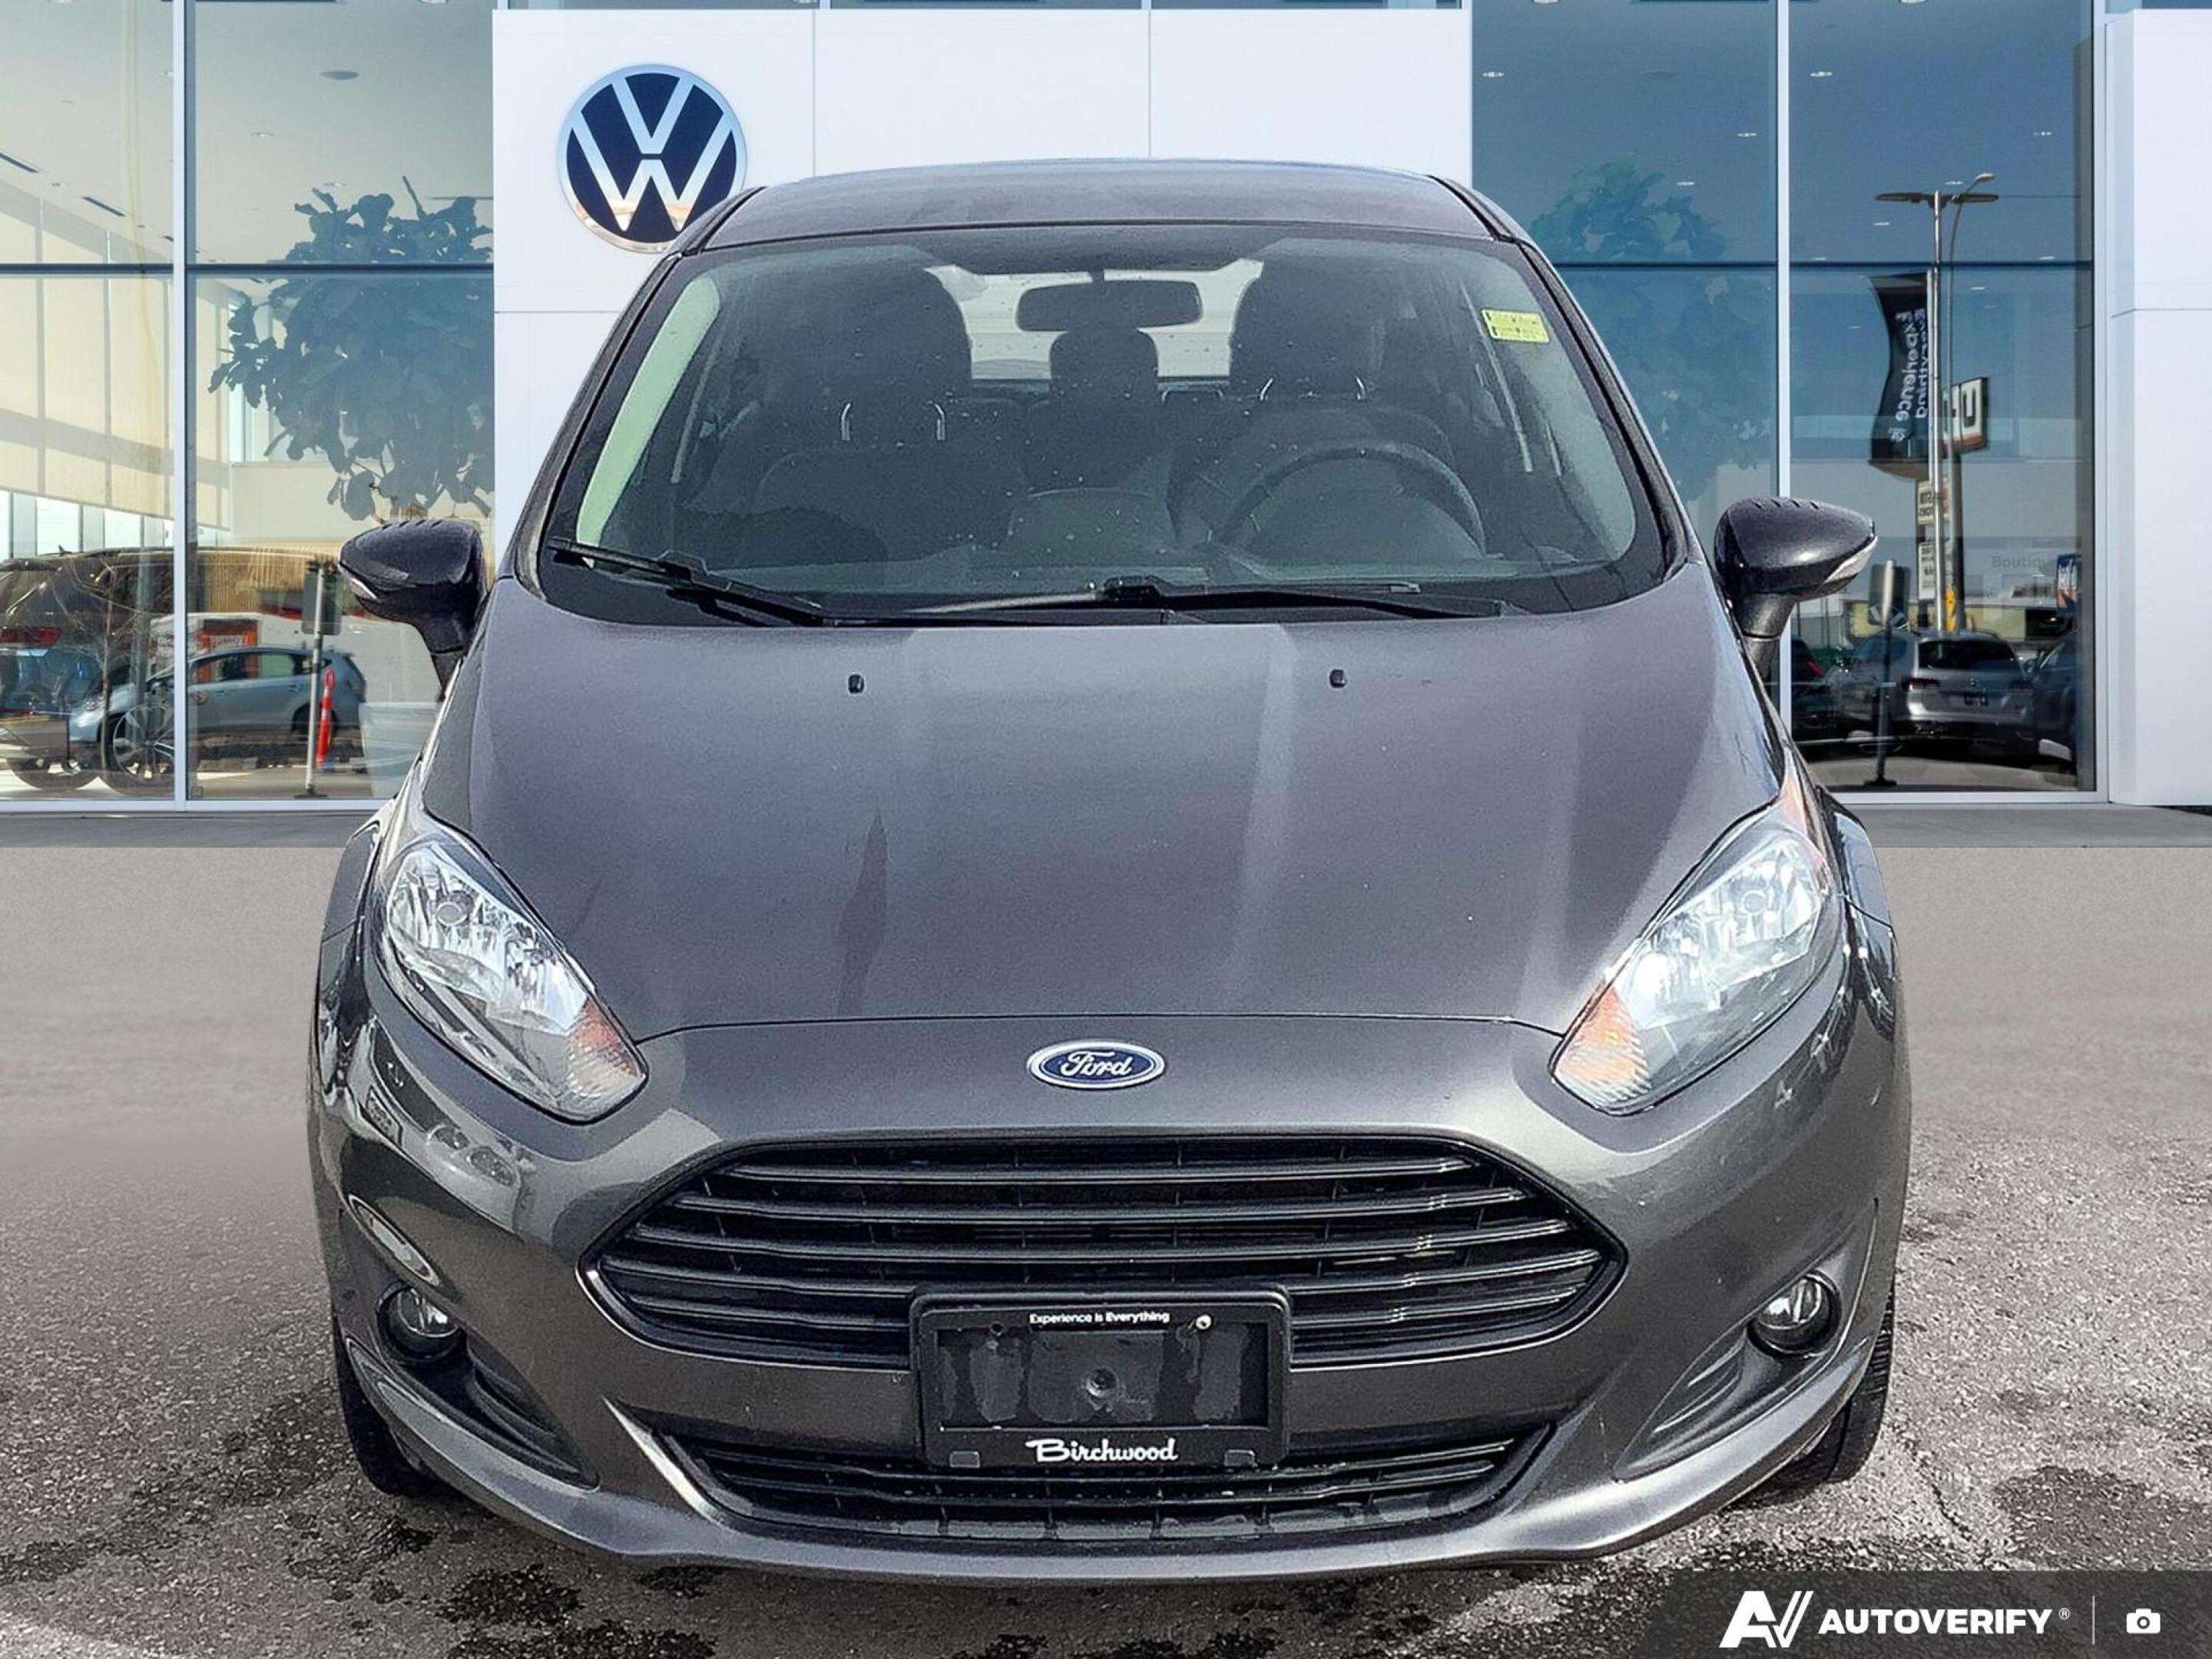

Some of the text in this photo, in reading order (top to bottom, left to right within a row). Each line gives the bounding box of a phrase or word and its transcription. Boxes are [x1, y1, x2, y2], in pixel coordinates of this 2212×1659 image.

[571, 72, 735, 232] VW
[1061, 1050, 1133, 1076] Ford
[1029, 1313, 1092, 1325] Experience
[1105, 1311, 1170, 1323] Everything
[1025, 1438, 1178, 1462] Birchwood
